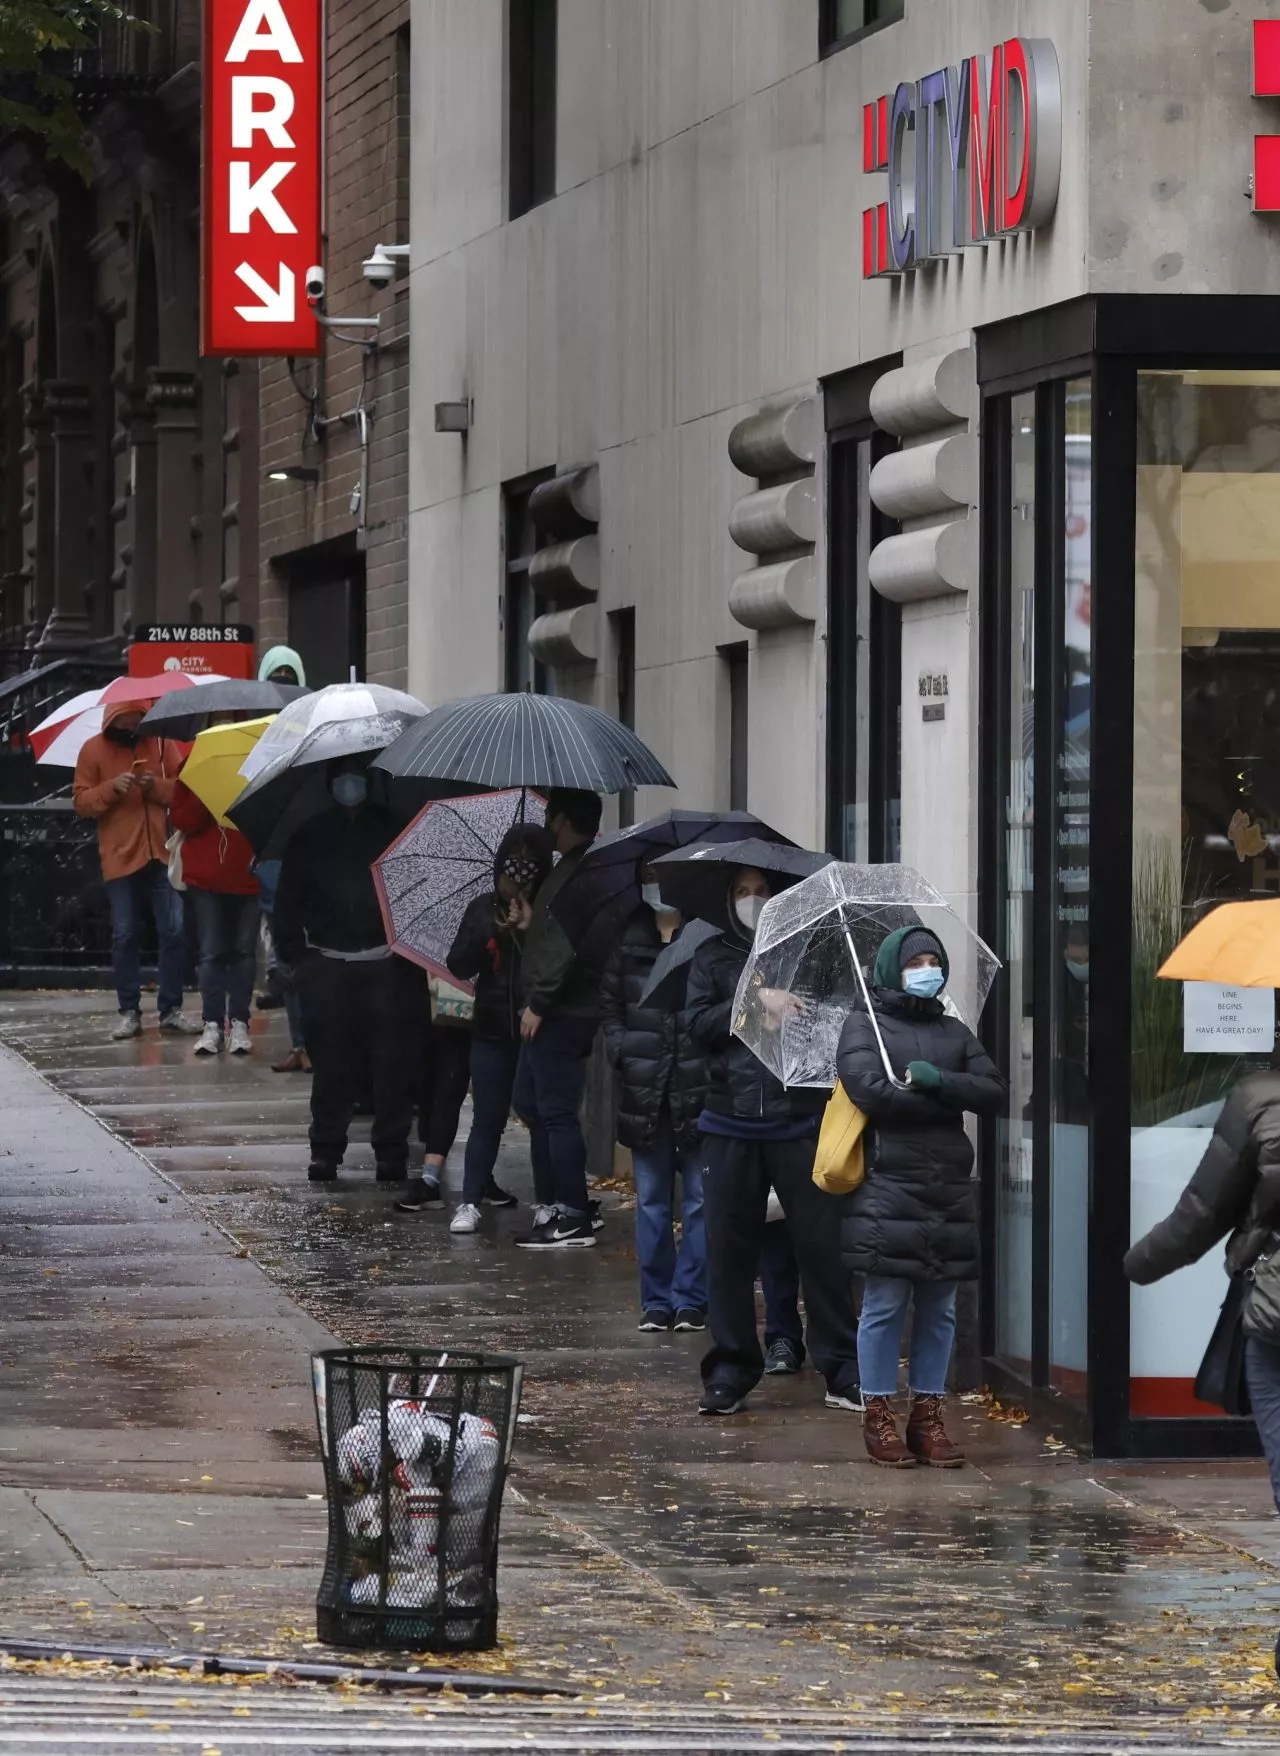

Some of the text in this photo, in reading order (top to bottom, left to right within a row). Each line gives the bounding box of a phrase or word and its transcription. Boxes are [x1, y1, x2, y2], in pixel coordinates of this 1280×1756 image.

[887, 37, 1061, 270] CITYMD
[148, 627, 239, 641] 214 W 88th St
[181, 657, 205, 666] CITY
